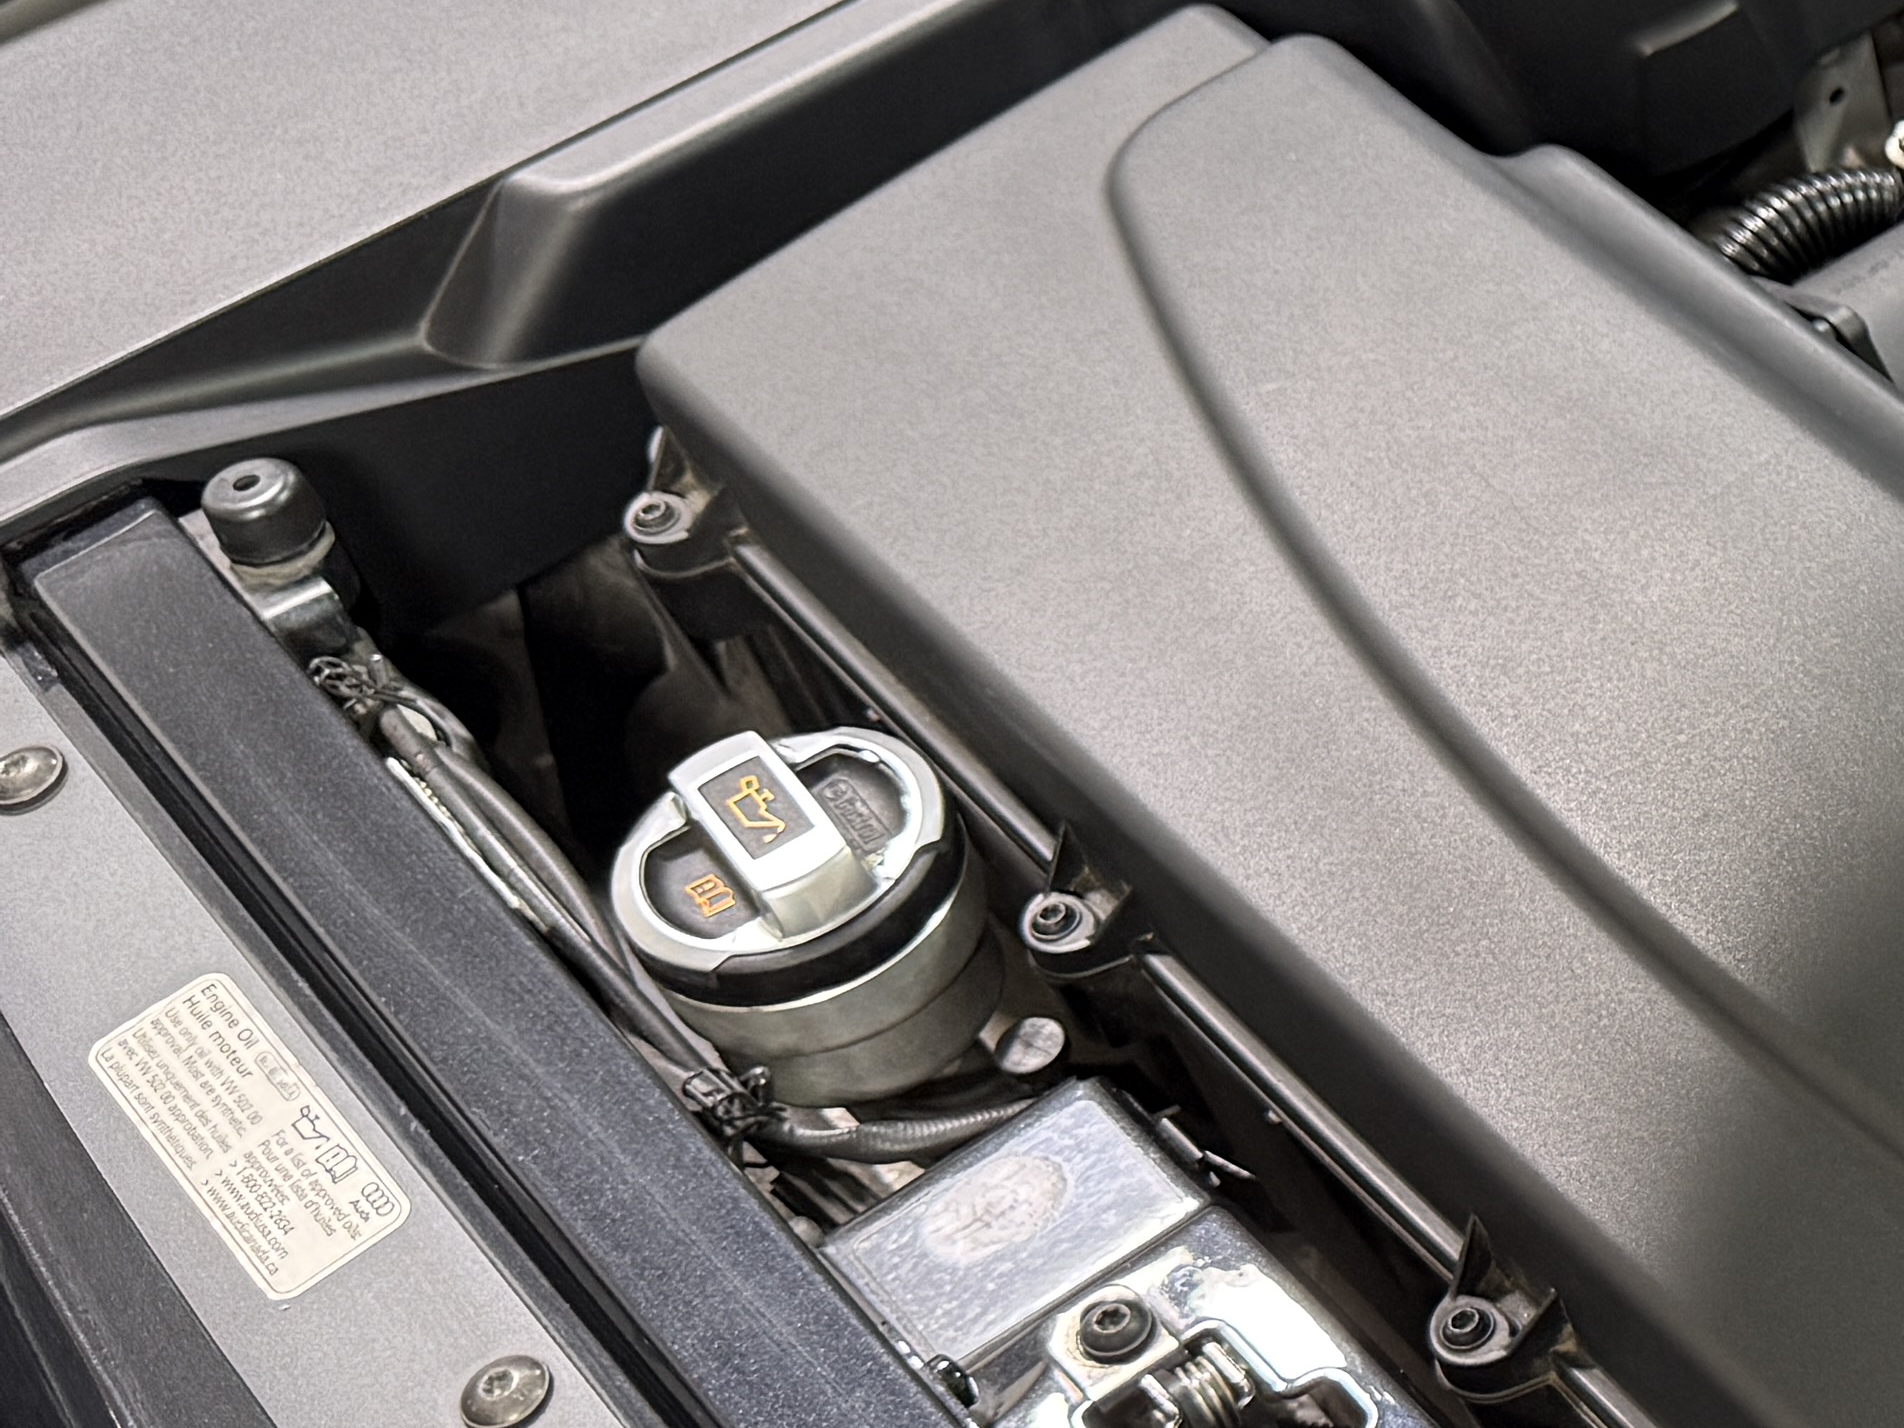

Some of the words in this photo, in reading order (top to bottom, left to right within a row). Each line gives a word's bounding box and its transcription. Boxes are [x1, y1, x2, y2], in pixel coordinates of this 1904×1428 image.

[182, 994, 212, 1030] Huile
[208, 1030, 253, 1077] moteur
[200, 983, 239, 1029] Engine
[236, 1027, 259, 1049] Oil
